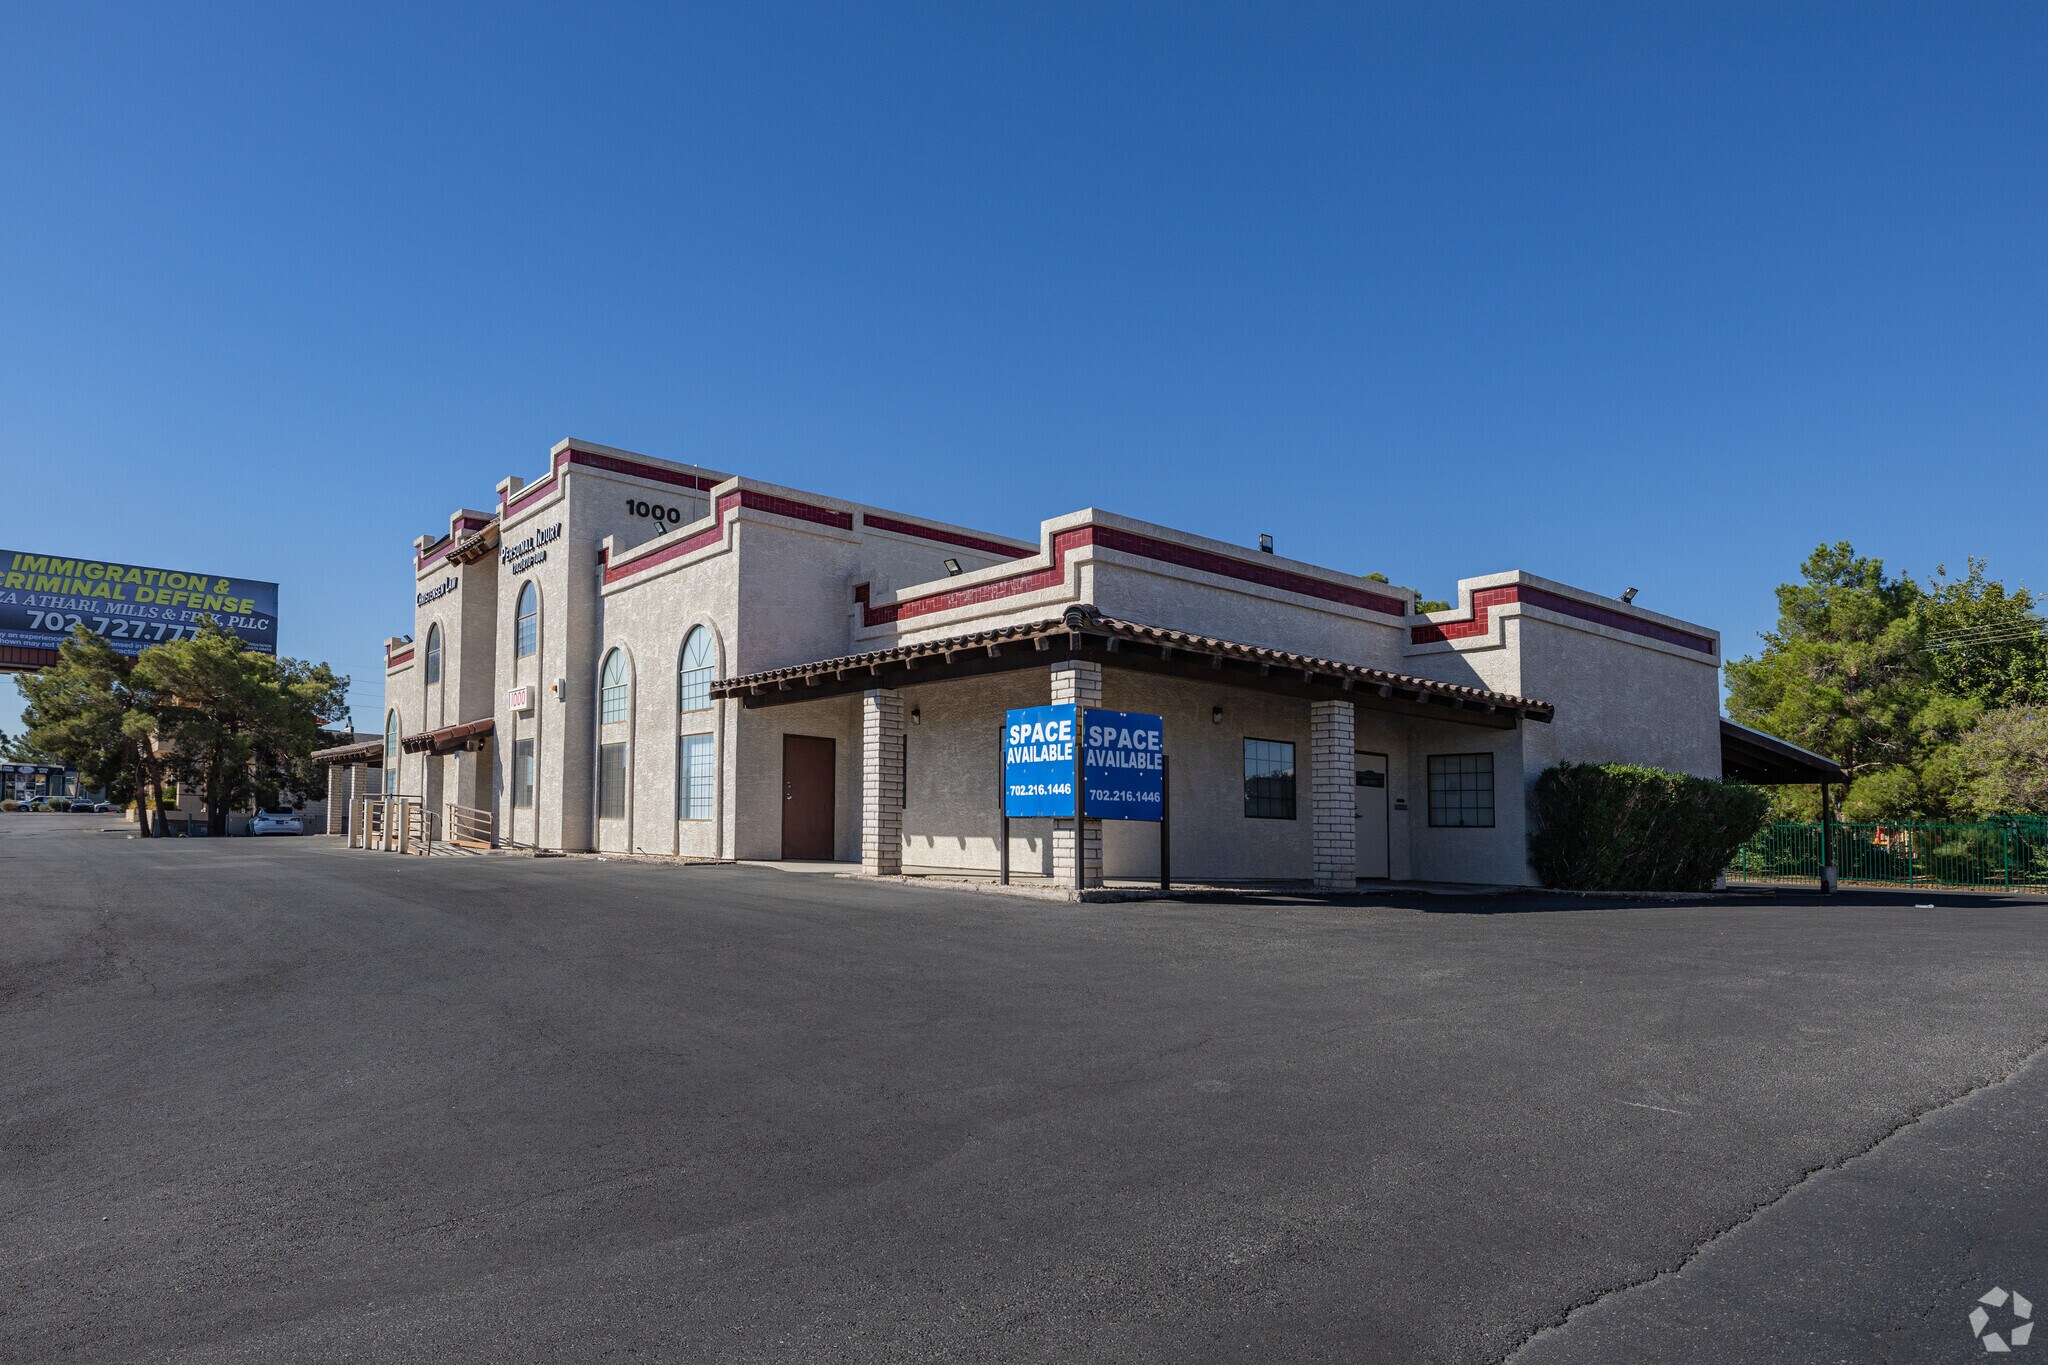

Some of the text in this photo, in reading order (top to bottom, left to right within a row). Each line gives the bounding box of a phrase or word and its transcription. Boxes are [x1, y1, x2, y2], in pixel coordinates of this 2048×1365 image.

[626, 499, 680, 523] 1000
[501, 537, 534, 565] PERSONAL
[11, 554, 230, 595] IMMIGRATION &
[22, 594, 100, 614] ATHARI,
[104, 603, 159, 619] MILLS
[161, 608, 176, 621] &
[227, 615, 269, 630] PLLC
[134, 586, 256, 615] DEFENSE
[511, 690, 525, 707] 1000
[1009, 720, 1072, 745] SPACE
[1088, 726, 1160, 750] SPACE
[1007, 743, 1073, 764] AVAILABLE
[1086, 749, 1162, 770] AVAILABLE
[1010, 783, 1071, 796] 702.216.1446
[1089, 790, 1161, 803] 702.216.1446
